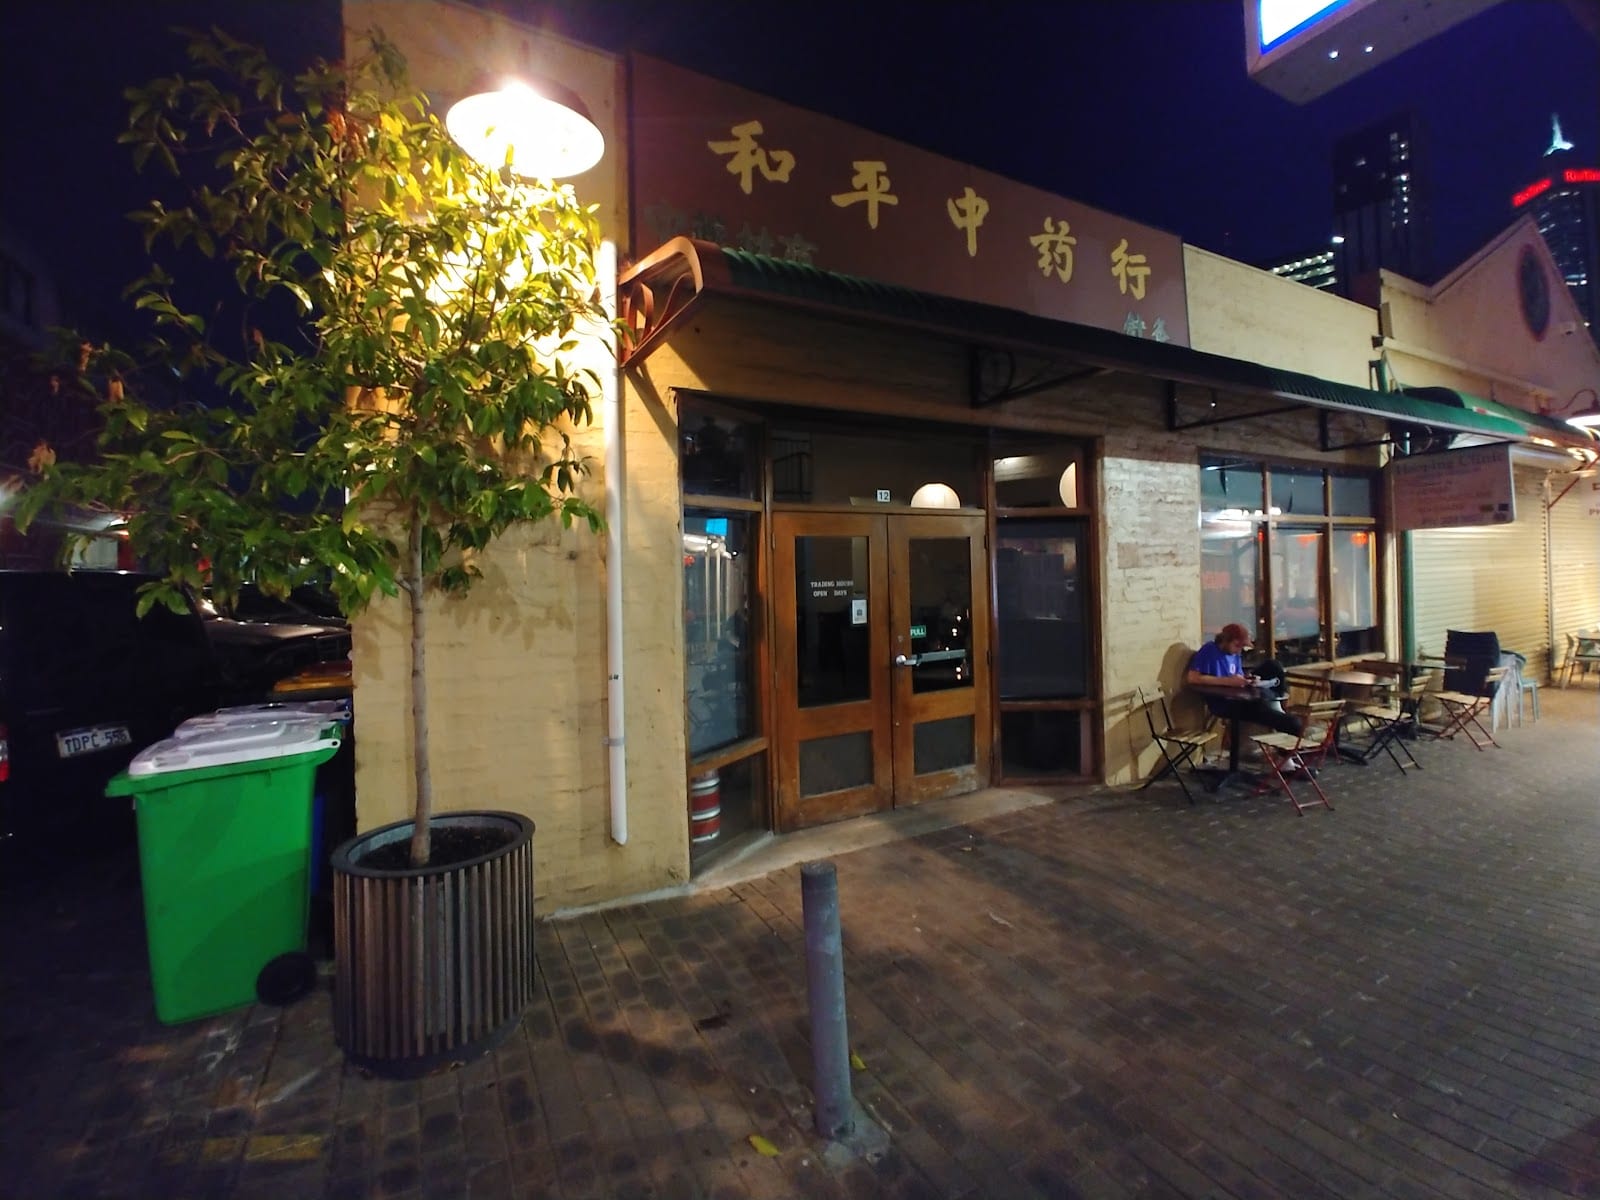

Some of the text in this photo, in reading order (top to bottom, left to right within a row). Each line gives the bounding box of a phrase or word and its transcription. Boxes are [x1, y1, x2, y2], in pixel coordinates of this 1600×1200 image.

[707, 120, 1152, 300] 和平中药行
[878, 491, 889, 501] 12
[810, 580, 835, 588] TRADING
[910, 628, 924, 636] PULL
